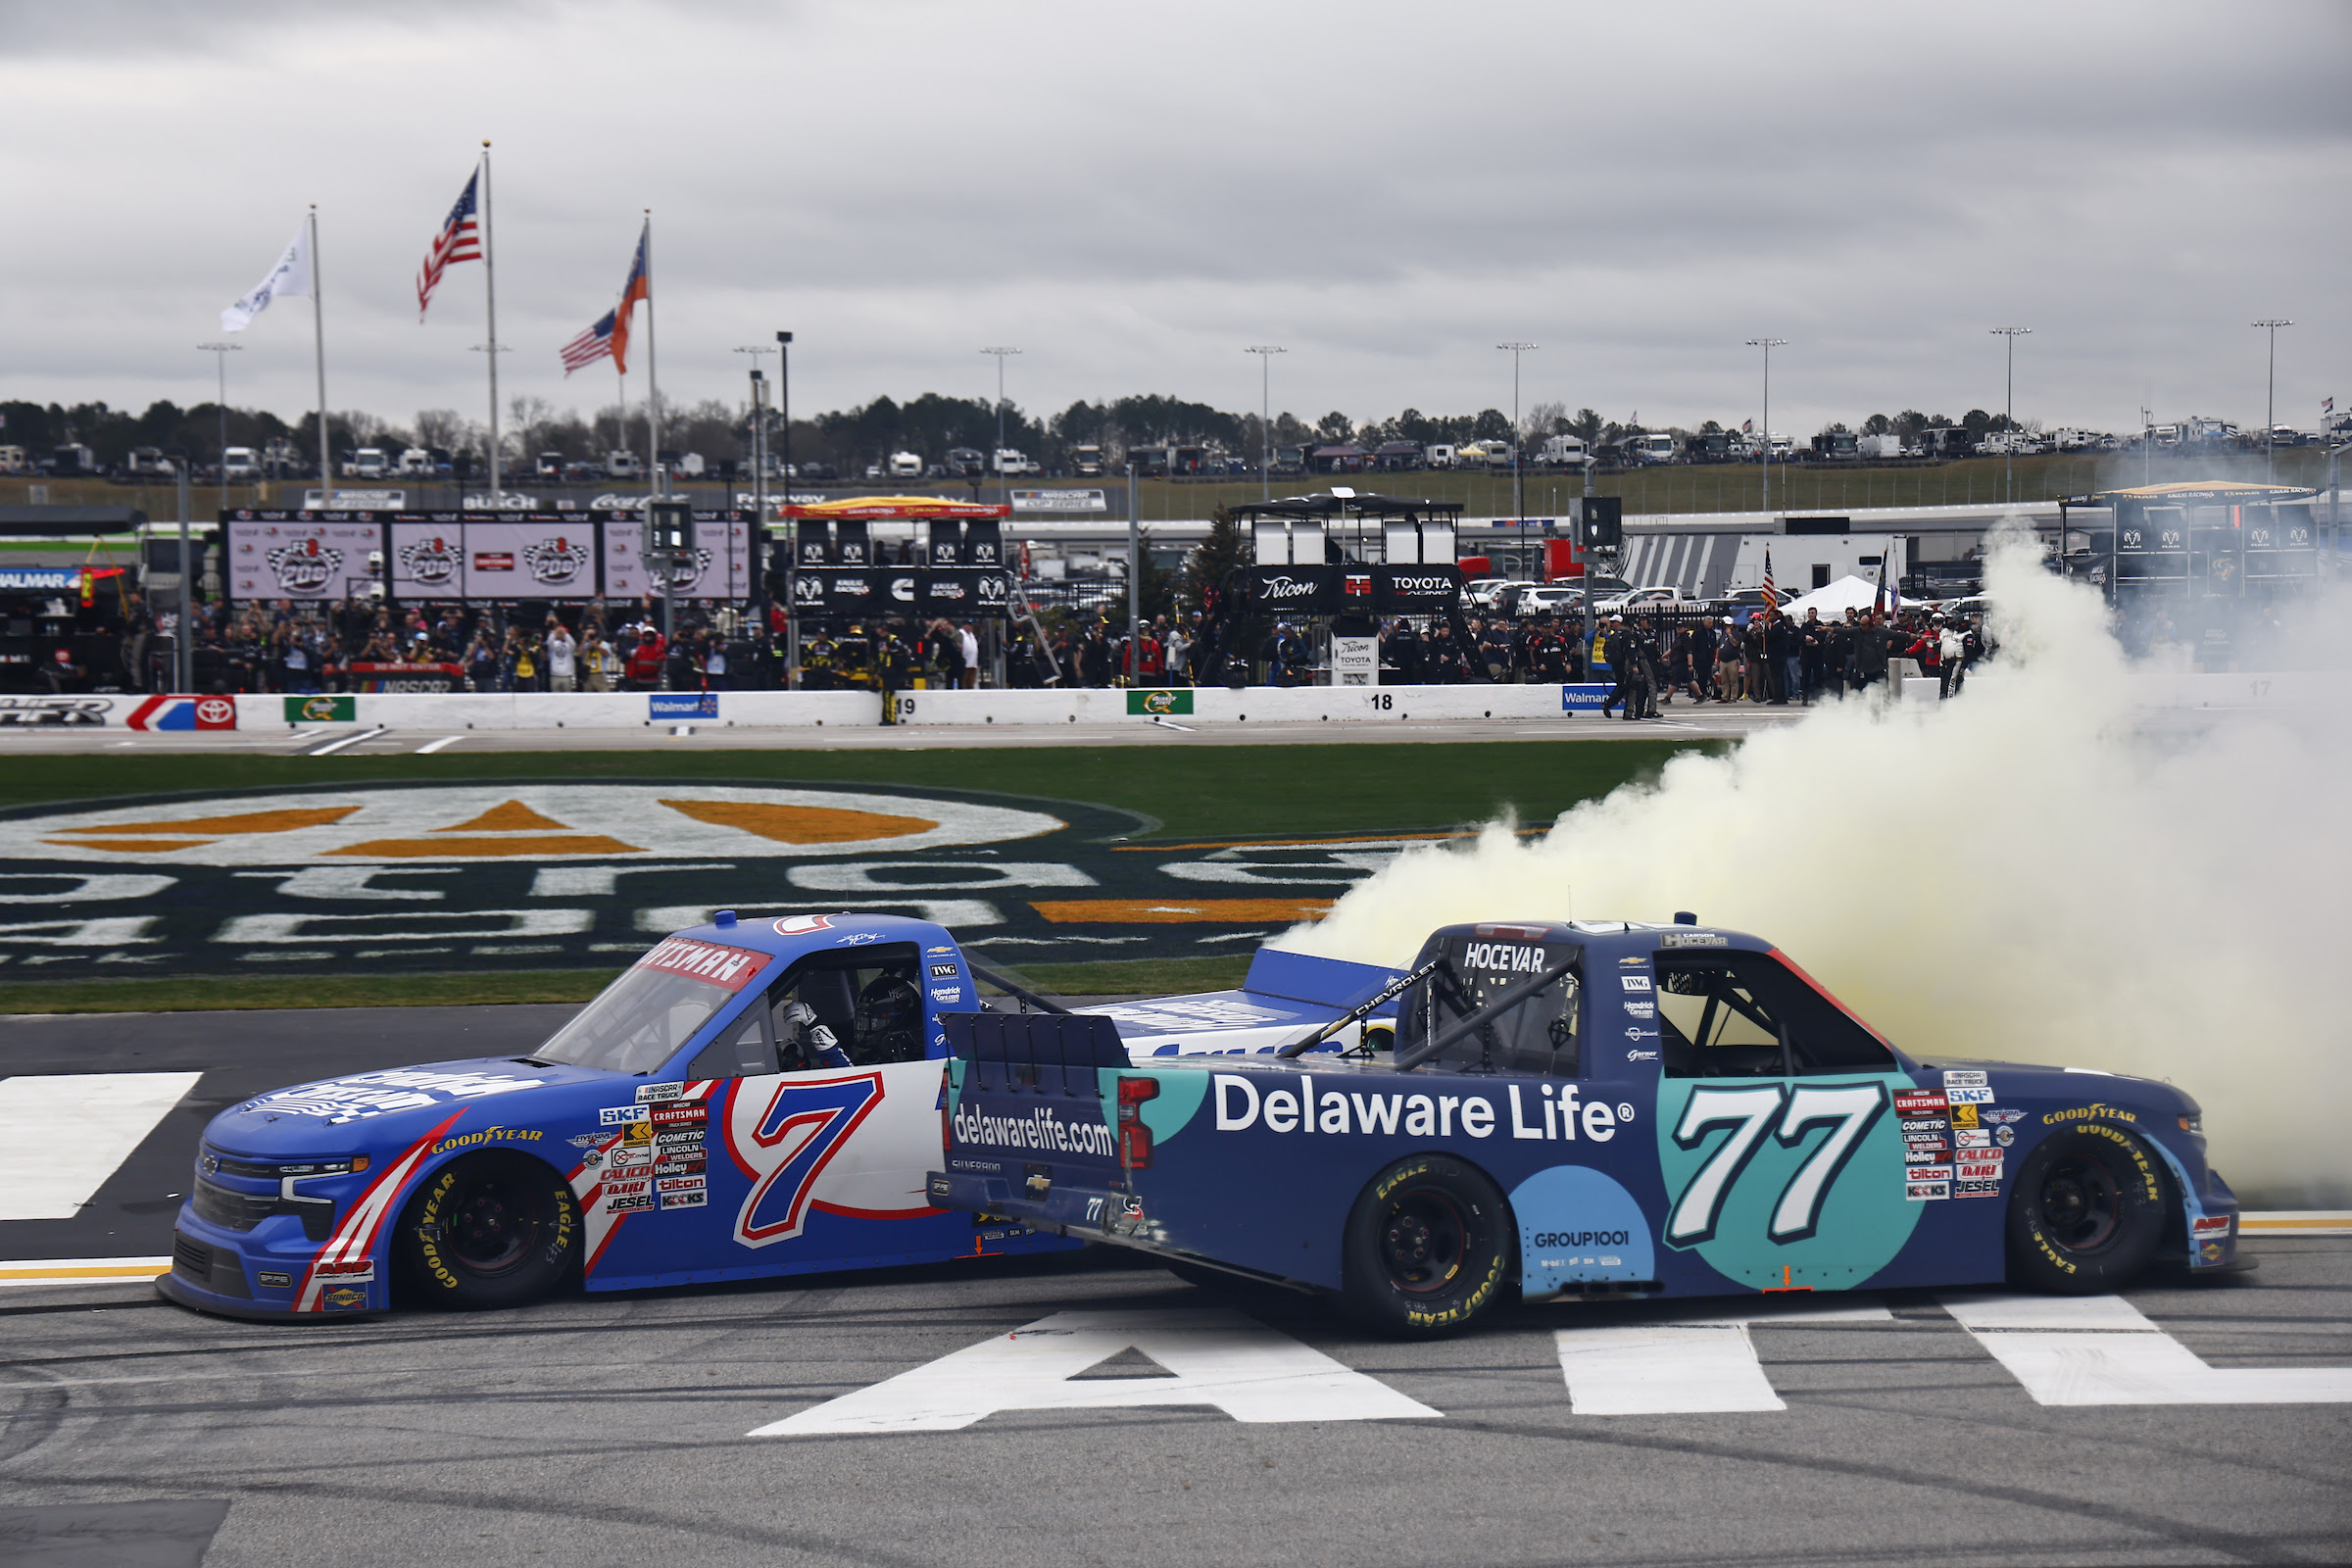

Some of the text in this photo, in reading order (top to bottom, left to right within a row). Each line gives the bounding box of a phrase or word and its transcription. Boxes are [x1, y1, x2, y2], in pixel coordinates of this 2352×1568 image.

[1259, 575, 1318, 599] Tricon
[1392, 577, 1452, 588] TOYOTA
[1341, 641, 1371, 653] Tricon
[374, 662, 390, 671] DO
[391, 662, 409, 671] NOT
[651, 701, 700, 712] Walmart
[896, 698, 915, 714] 19
[1371, 694, 1393, 710] 18
[1660, 933, 1729, 949] HOCEVAR
[1464, 942, 1545, 973] HOCEVAR
[932, 964, 956, 975] TWG
[1355, 960, 1437, 1016] CHEVROLET
[1624, 978, 1648, 988] TWG
[930, 986, 961, 998] Hendrick
[1624, 1001, 1655, 1011] Hendrick
[1627, 1050, 1658, 1062] Garner
[651, 1084, 678, 1094] NASCAR
[1949, 1089, 1990, 1102] SKF
[638, 1091, 679, 1102] RACE TRUCK
[1897, 1098, 1945, 1108] CRAFTSMAN
[1214, 1074, 1495, 1139] Delaware
[603, 1107, 647, 1123] SKF
[654, 1108, 706, 1121] CRAFTSMAN
[2042, 1102, 2136, 1125] GOODYEAR
[955, 1102, 1113, 1157] delawarelife.com
[1902, 1120, 1946, 1130] COMETIC
[431, 1125, 543, 1154] GOODYEAR
[659, 1130, 705, 1144] COMETIC
[1903, 1134, 1938, 1143] LINCOLN
[662, 1145, 699, 1154] LINCOLN
[1956, 1149, 2002, 1160] CALICO
[669, 1152, 703, 1161] WELDERS
[733, 1071, 885, 1250] 7
[1905, 1152, 1936, 1164] Holley
[600, 1165, 651, 1180] CALICO
[655, 1163, 687, 1175] Holley
[1663, 1080, 1891, 1252] 77
[1909, 1169, 1950, 1180] tilton
[659, 1178, 704, 1191] tilton
[1376, 1163, 1428, 1200] EAGLE
[1956, 1180, 1999, 1193] JESEL
[1907, 1186, 1946, 1198] KOOKS
[608, 1195, 656, 1210] JESEL
[662, 1192, 705, 1207] KOOKS
[1086, 1198, 1103, 1221] 77
[555, 1190, 572, 1249] EAGLE
[2193, 1216, 2230, 1231] ARP
[418, 1173, 459, 1289] GOODYEAR
[1535, 1230, 1629, 1249] GROUP1001
[2033, 1230, 2078, 1275] EAGLE
[315, 1260, 372, 1275] ARP
[325, 1292, 367, 1302] SUNOCO
